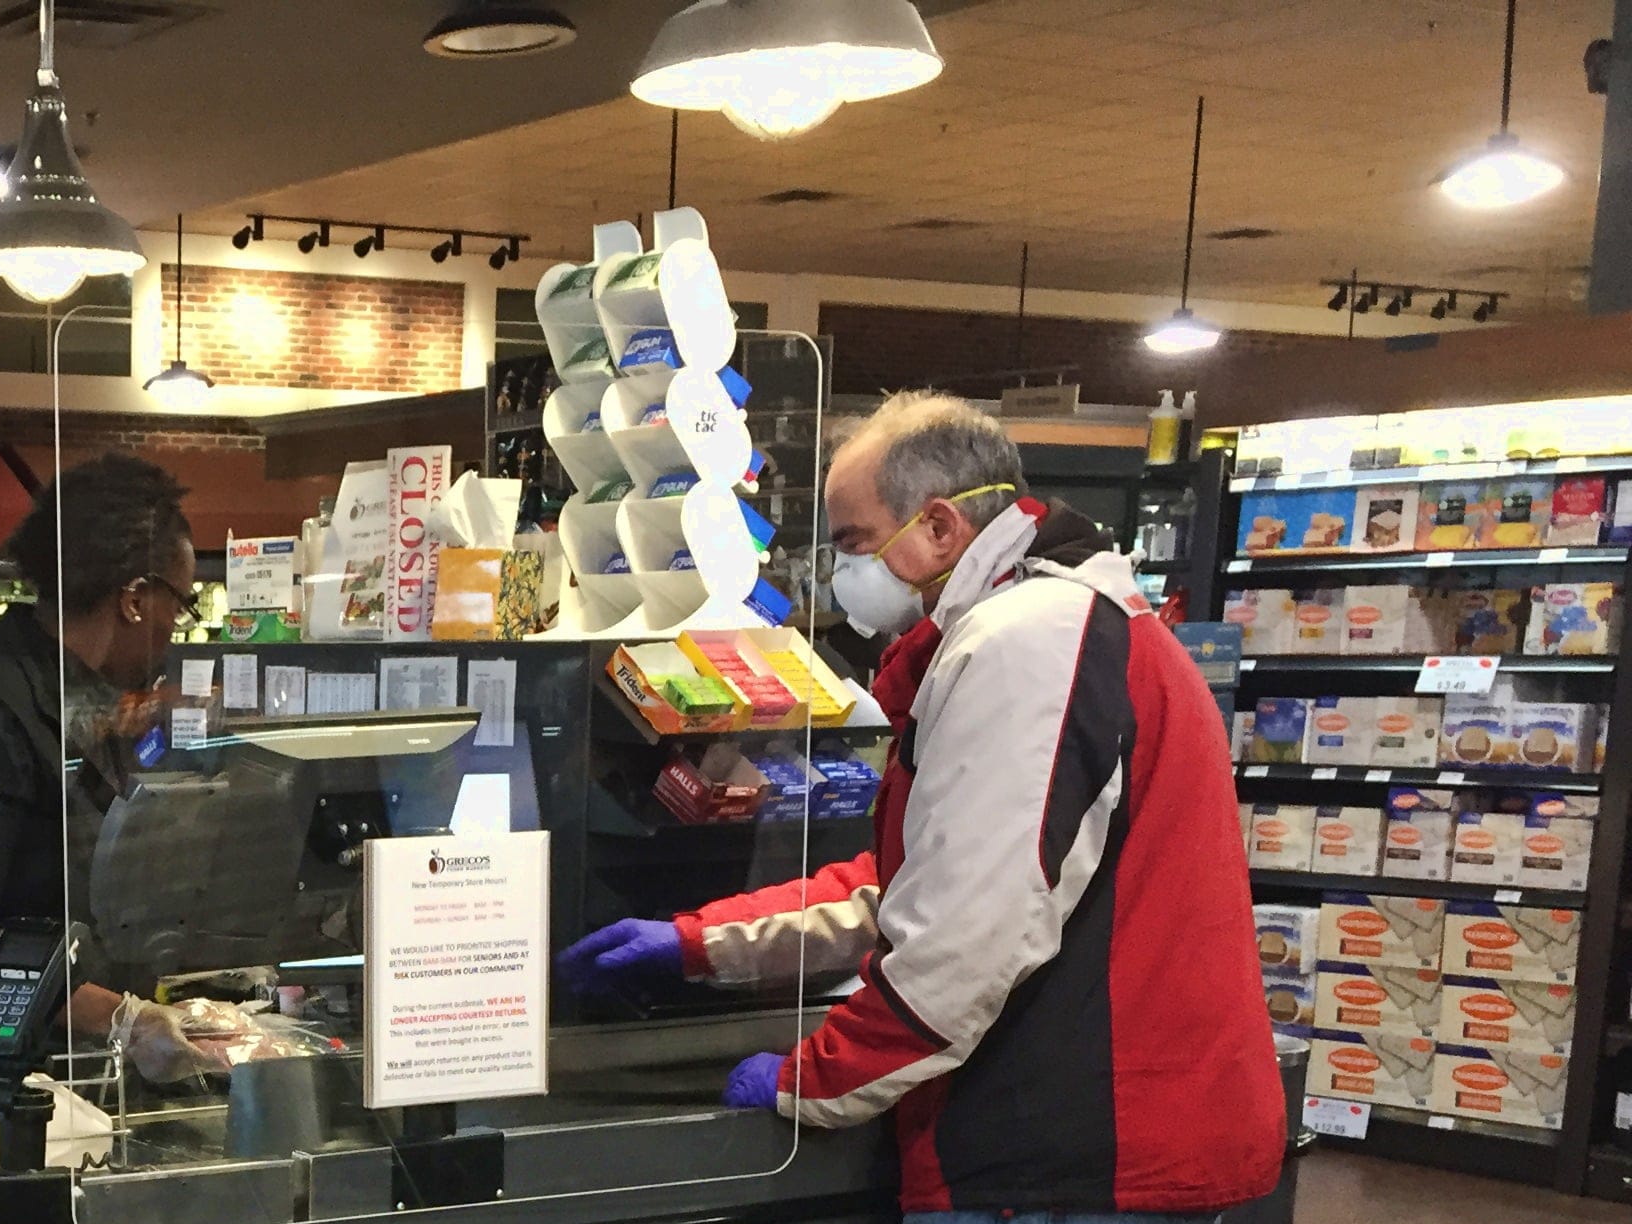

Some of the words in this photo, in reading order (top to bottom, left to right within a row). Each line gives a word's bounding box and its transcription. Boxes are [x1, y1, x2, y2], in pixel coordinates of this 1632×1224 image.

[700, 410, 719, 422] tic
[695, 421, 719, 433] tac
[432, 454, 443, 491] THIS
[388, 473, 397, 520] PLEASE
[388, 523, 397, 546] USE
[229, 543, 258, 557] nutella
[397, 456, 428, 633] CLOSED
[387, 550, 396, 581] NEXT
[386, 584, 395, 615] LANE
[616, 664, 646, 703] Trident
[670, 765, 698, 797] HALLS
[429, 880, 464, 888] Temporary
[390, 947, 400, 955] WE
[403, 946, 429, 954] WOULD
[431, 944, 444, 952] LIKE
[456, 941, 492, 950] PRIORITIZE
[494, 939, 528, 948] SHOPPING
[389, 959, 421, 967] BETWEEN
[473, 953, 502, 961] SENIORS
[411, 969, 452, 978] CUSTOMERS
[479, 964, 524, 974] COMMUNITY
[392, 1004, 414, 1012] During
[429, 1002, 452, 1010] current
[390, 1016, 418, 1025] LONGER
[419, 1013, 457, 1023] ACCEPTING
[458, 1011, 492, 1020] COURTESY
[404, 1028, 431, 1036] includes
[452, 1024, 473, 1034] picked
[448, 1037, 471, 1046] bought
[400, 1060, 412, 1068] will
[414, 1058, 435, 1067] accept
[437, 1056, 460, 1064] returns
[472, 1054, 483, 1062] any
[485, 1052, 510, 1062] product
[383, 1071, 413, 1081] defective
[447, 1067, 463, 1075] meet
[478, 1064, 500, 1074] quality
